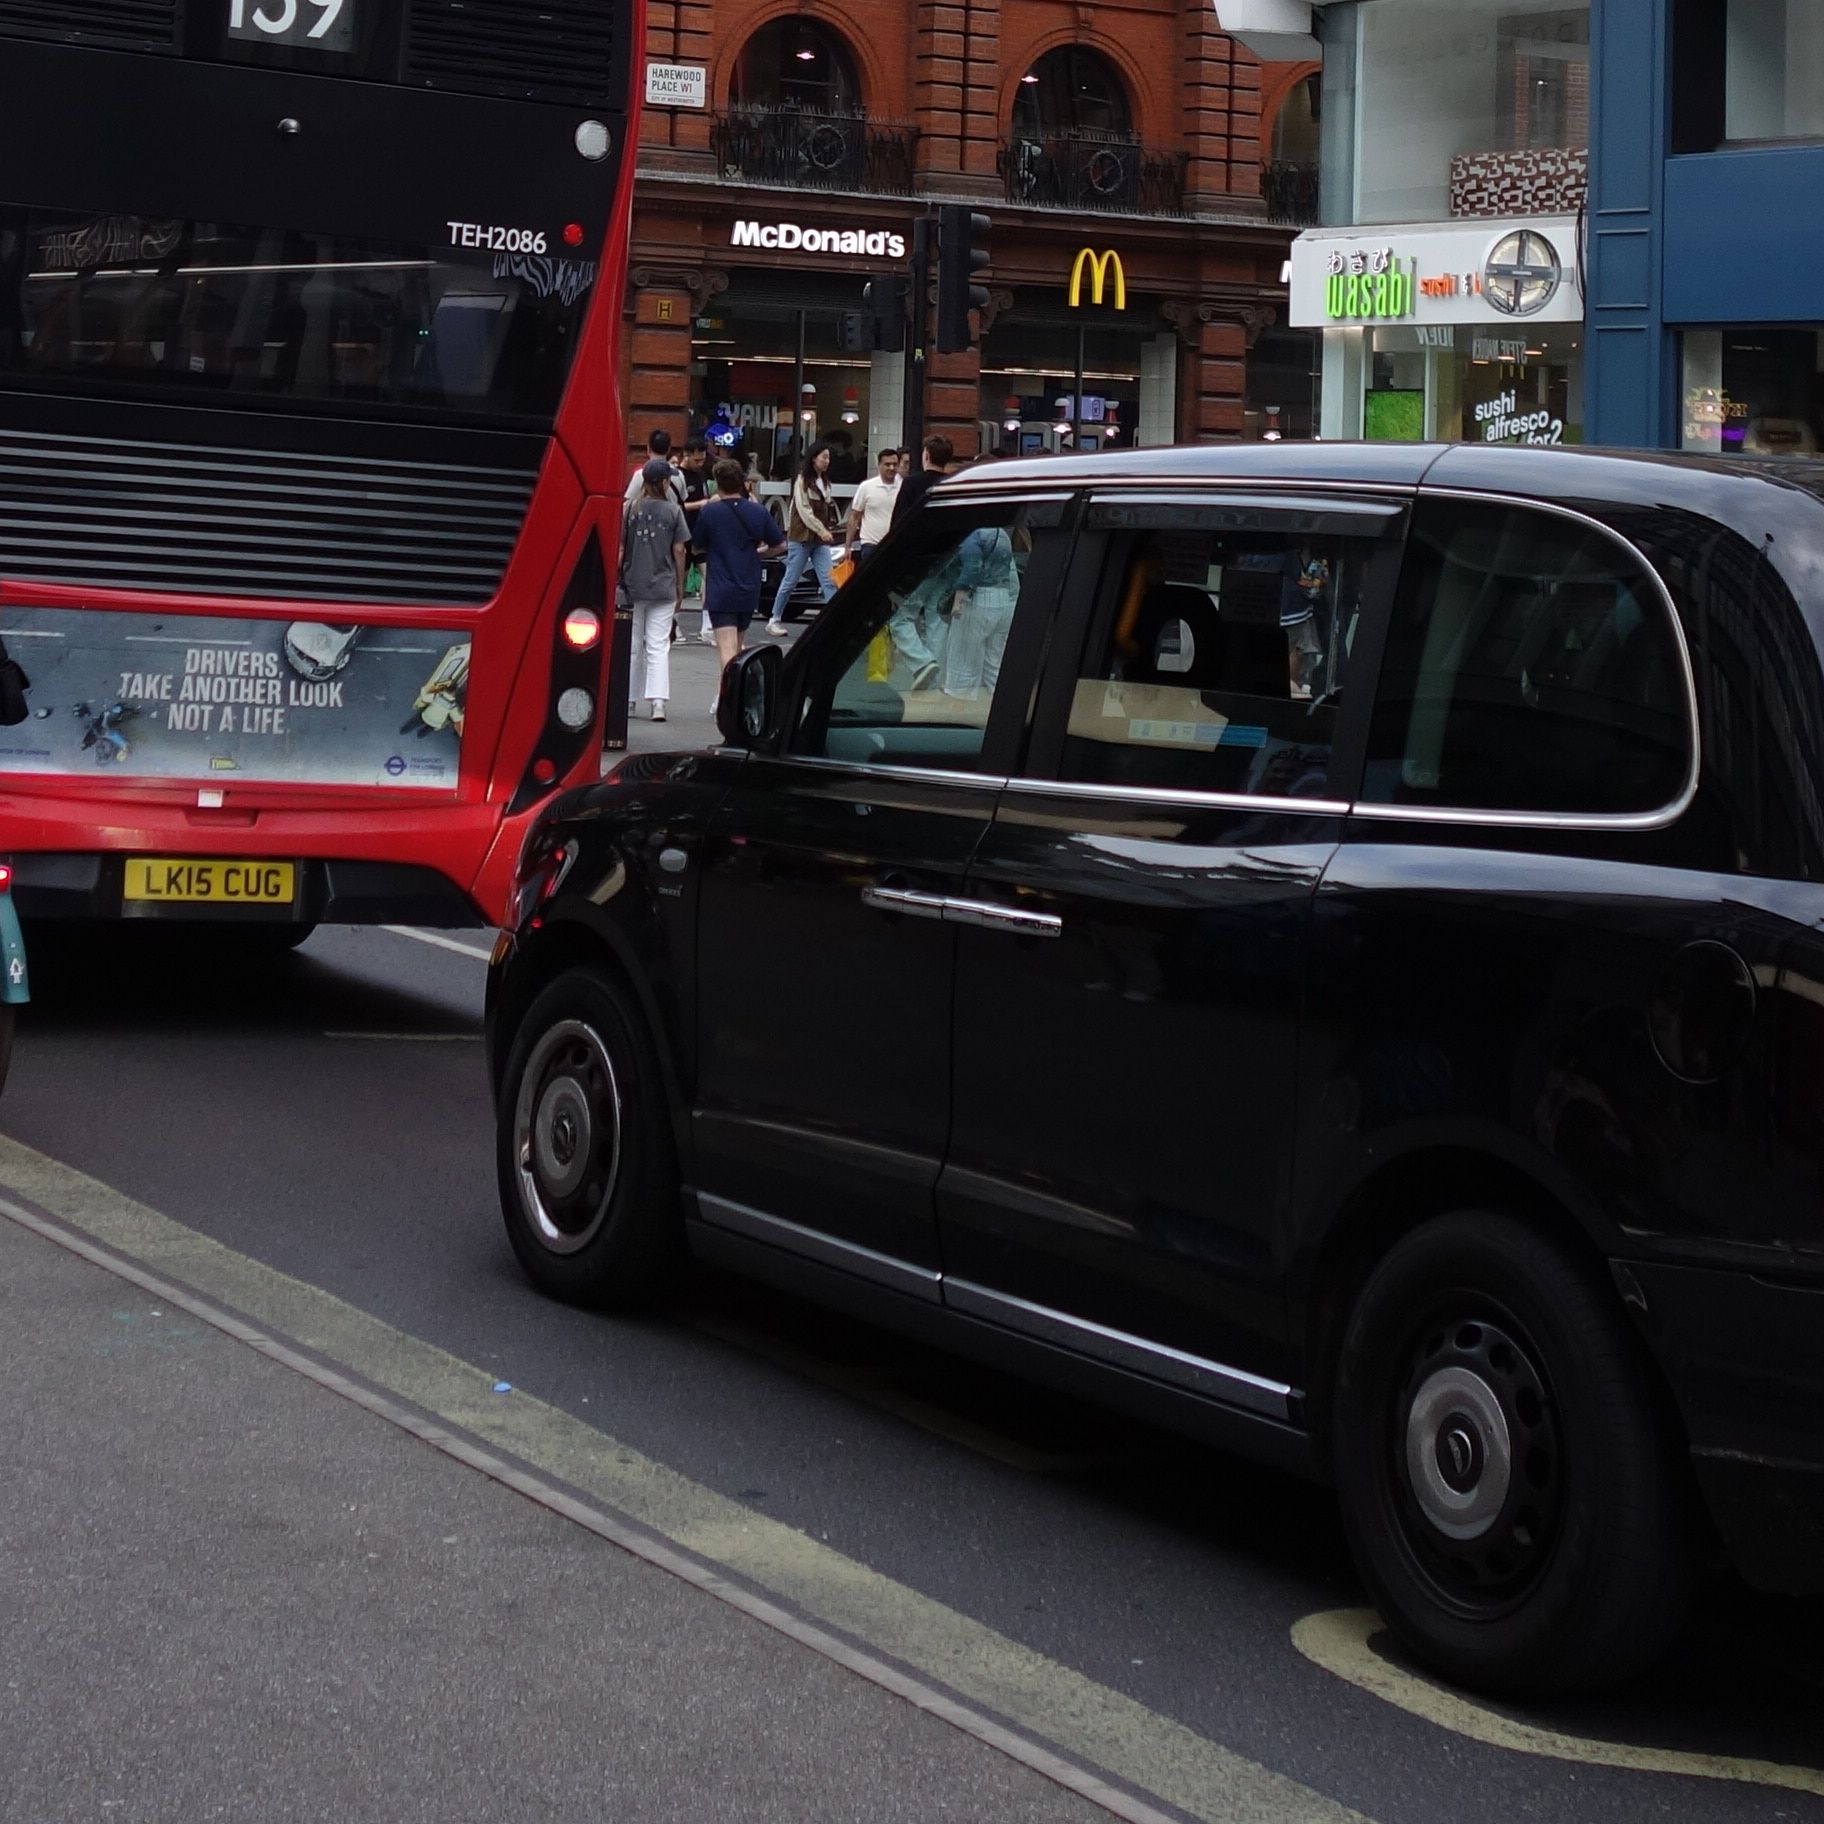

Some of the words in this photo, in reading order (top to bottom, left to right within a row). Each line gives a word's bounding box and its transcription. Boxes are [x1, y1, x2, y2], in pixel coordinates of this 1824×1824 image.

[651, 80, 678, 93] PLACE
[680, 82, 692, 94] W1
[652, 67, 701, 82] HAREWOOD
[446, 221, 547, 255] TEH2086
[730, 220, 906, 258] McDonald's
[1327, 247, 1393, 275] わさび
[1325, 255, 1417, 319] wasabi
[1418, 272, 1459, 297] sushi
[1475, 389, 1516, 422] sushi
[1486, 410, 1549, 442] alfresco
[184, 648, 284, 679] DRIVERS,
[118, 672, 173, 701] TAKE
[179, 675, 282, 705] ANOTHER
[289, 681, 344, 708] LOOK
[168, 703, 213, 732] NOT
[219, 707, 233, 733] A
[242, 707, 291, 735] LIFE.
[145, 865, 212, 896] LK15
[224, 868, 281, 897] CUG
